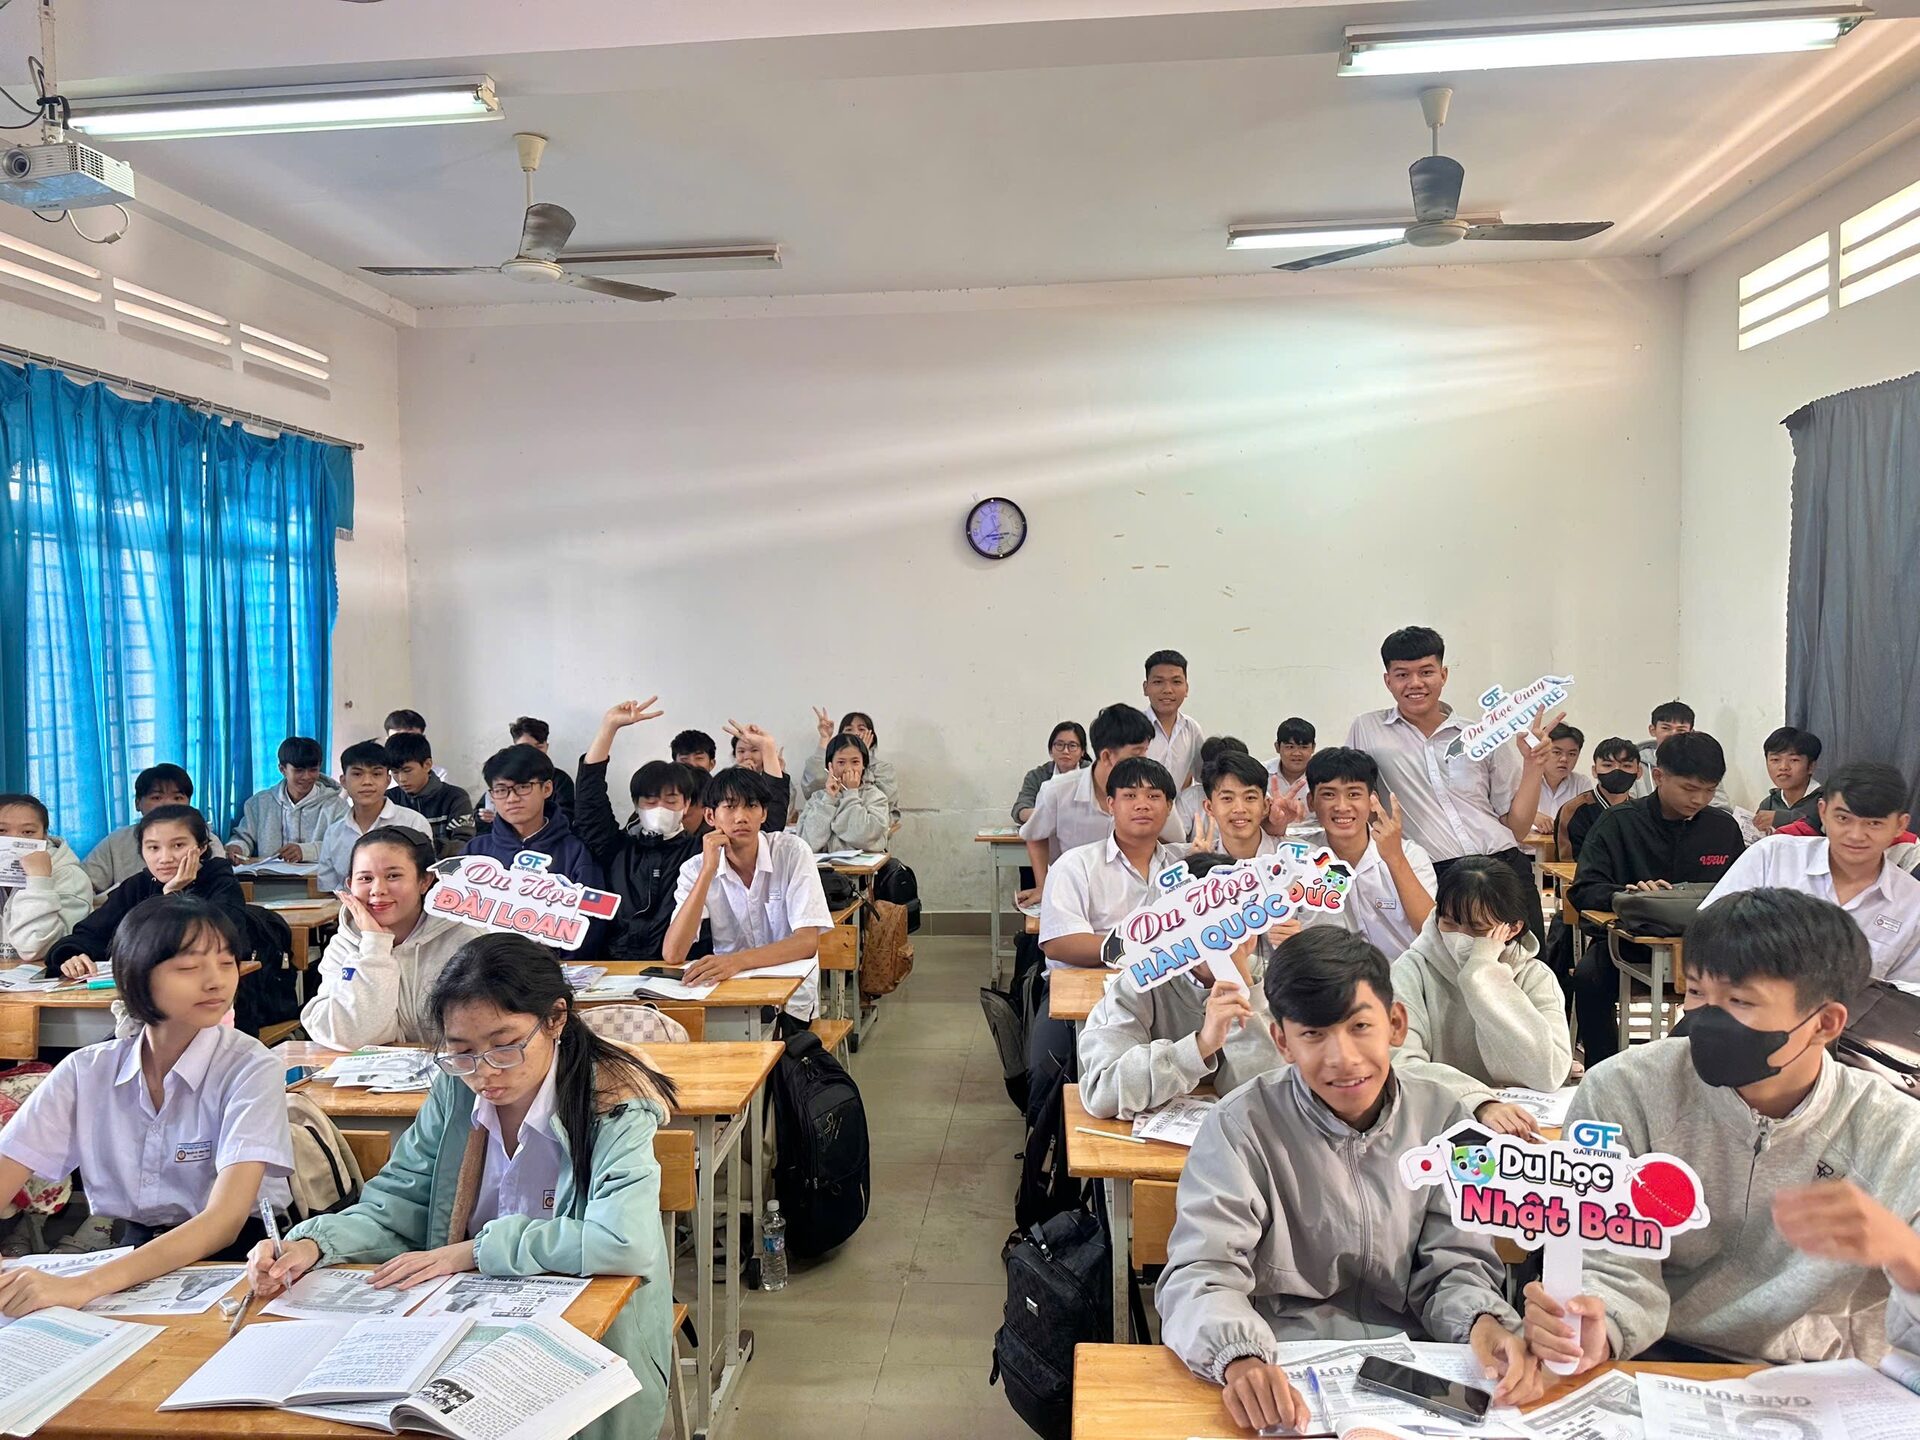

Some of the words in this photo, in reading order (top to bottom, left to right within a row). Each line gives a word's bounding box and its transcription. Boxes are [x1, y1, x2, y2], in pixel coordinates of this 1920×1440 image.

[1482, 687, 1499, 706] GF
[1463, 723, 1485, 741] Du
[1485, 704, 1513, 725] Học
[1470, 727, 1510, 758] GATE
[518, 853, 547, 868] GF
[1159, 864, 1183, 888] GF
[465, 862, 512, 890] Du
[518, 874, 580, 907] Học
[433, 885, 496, 922] ĐÀI
[492, 902, 582, 944] LOAN
[1127, 908, 1185, 944] Du
[1186, 872, 1259, 915] Học
[1130, 937, 1200, 987] HÀN
[1201, 893, 1290, 951] QUỐC
[1574, 1122, 1621, 1149] GF
[1573, 1147, 1592, 1156] GATE
[1593, 1149, 1621, 1160] FUTURE
[1499, 1144, 1546, 1184] Du
[1550, 1151, 1614, 1196] học
[1461, 1184, 1570, 1241] Nhật
[1579, 1201, 1662, 1250] Bản
[1655, 1380, 1747, 1406] FUTURE
[1749, 1394, 1813, 1409] GATE
